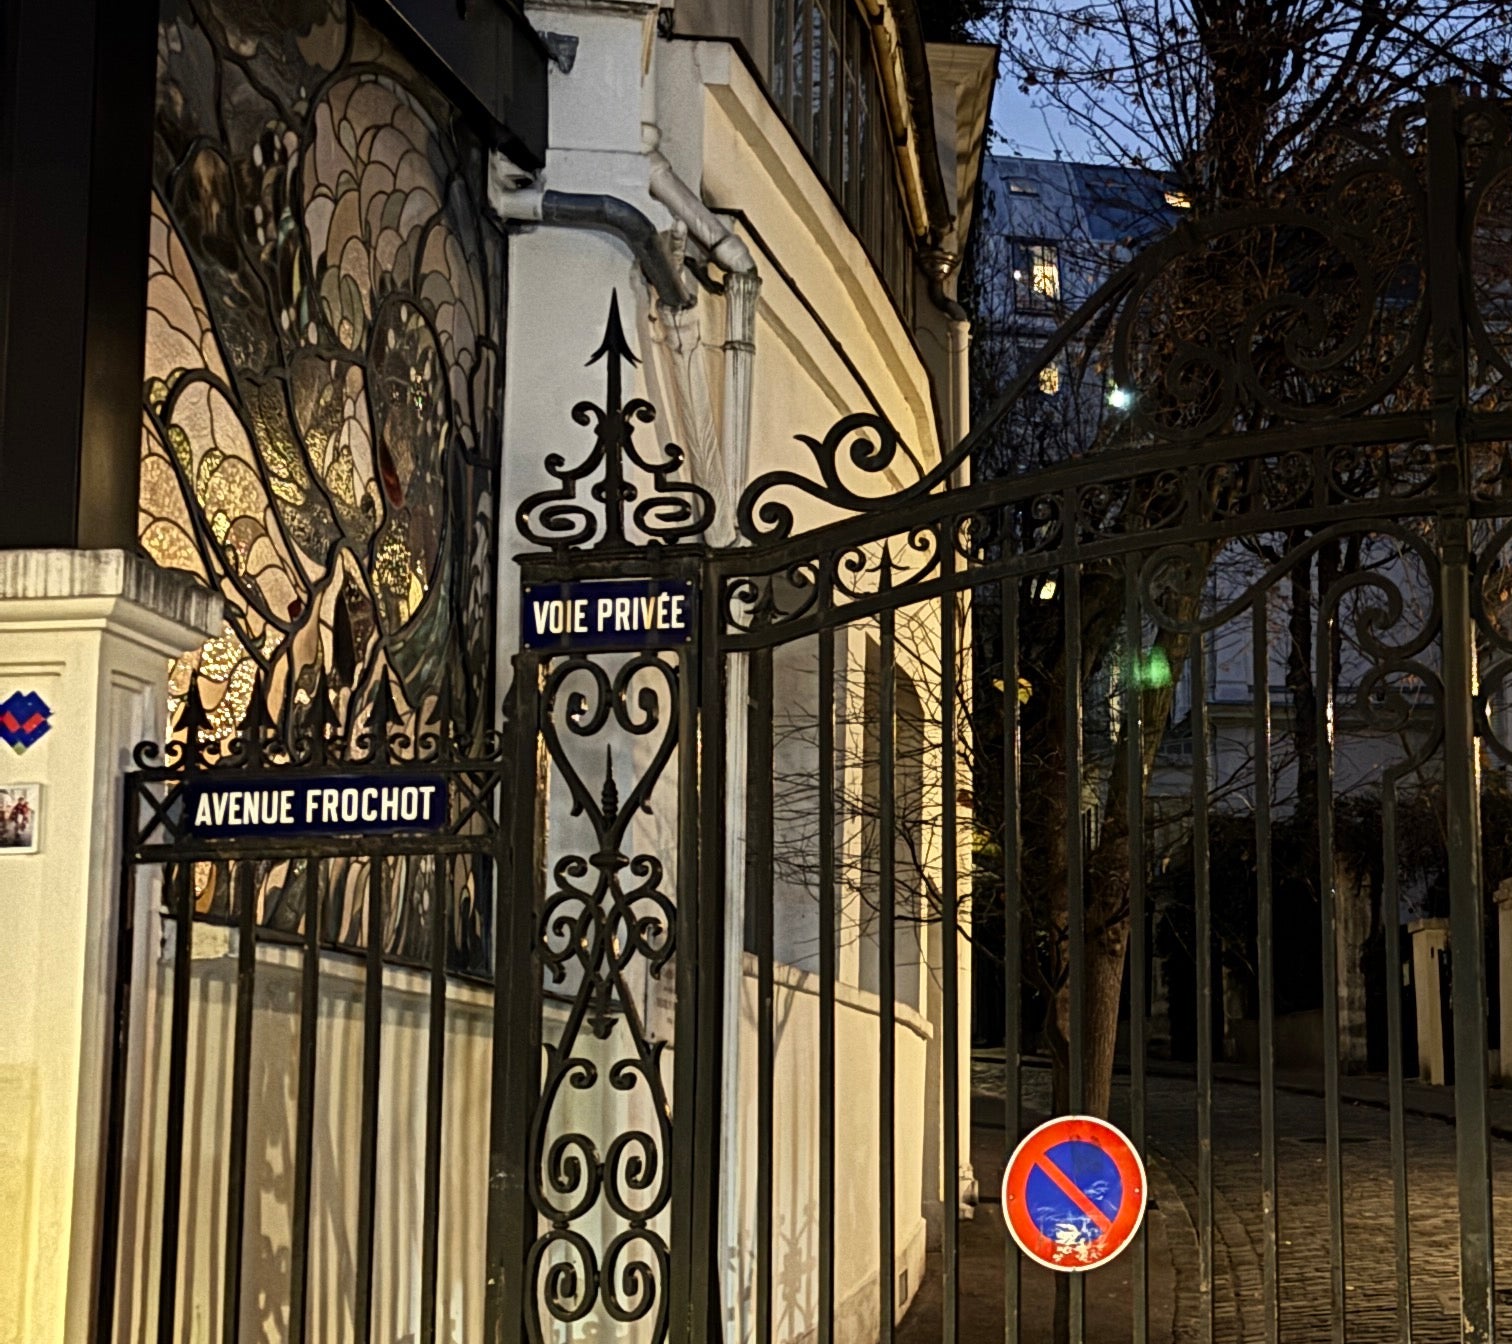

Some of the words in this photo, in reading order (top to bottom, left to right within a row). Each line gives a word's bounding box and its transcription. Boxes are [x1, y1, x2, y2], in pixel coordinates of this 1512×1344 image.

[533, 599, 589, 635] VOIE
[597, 591, 686, 632] PRIVÉE
[194, 790, 295, 826] AVENUE
[305, 785, 436, 824] FROCHOT
